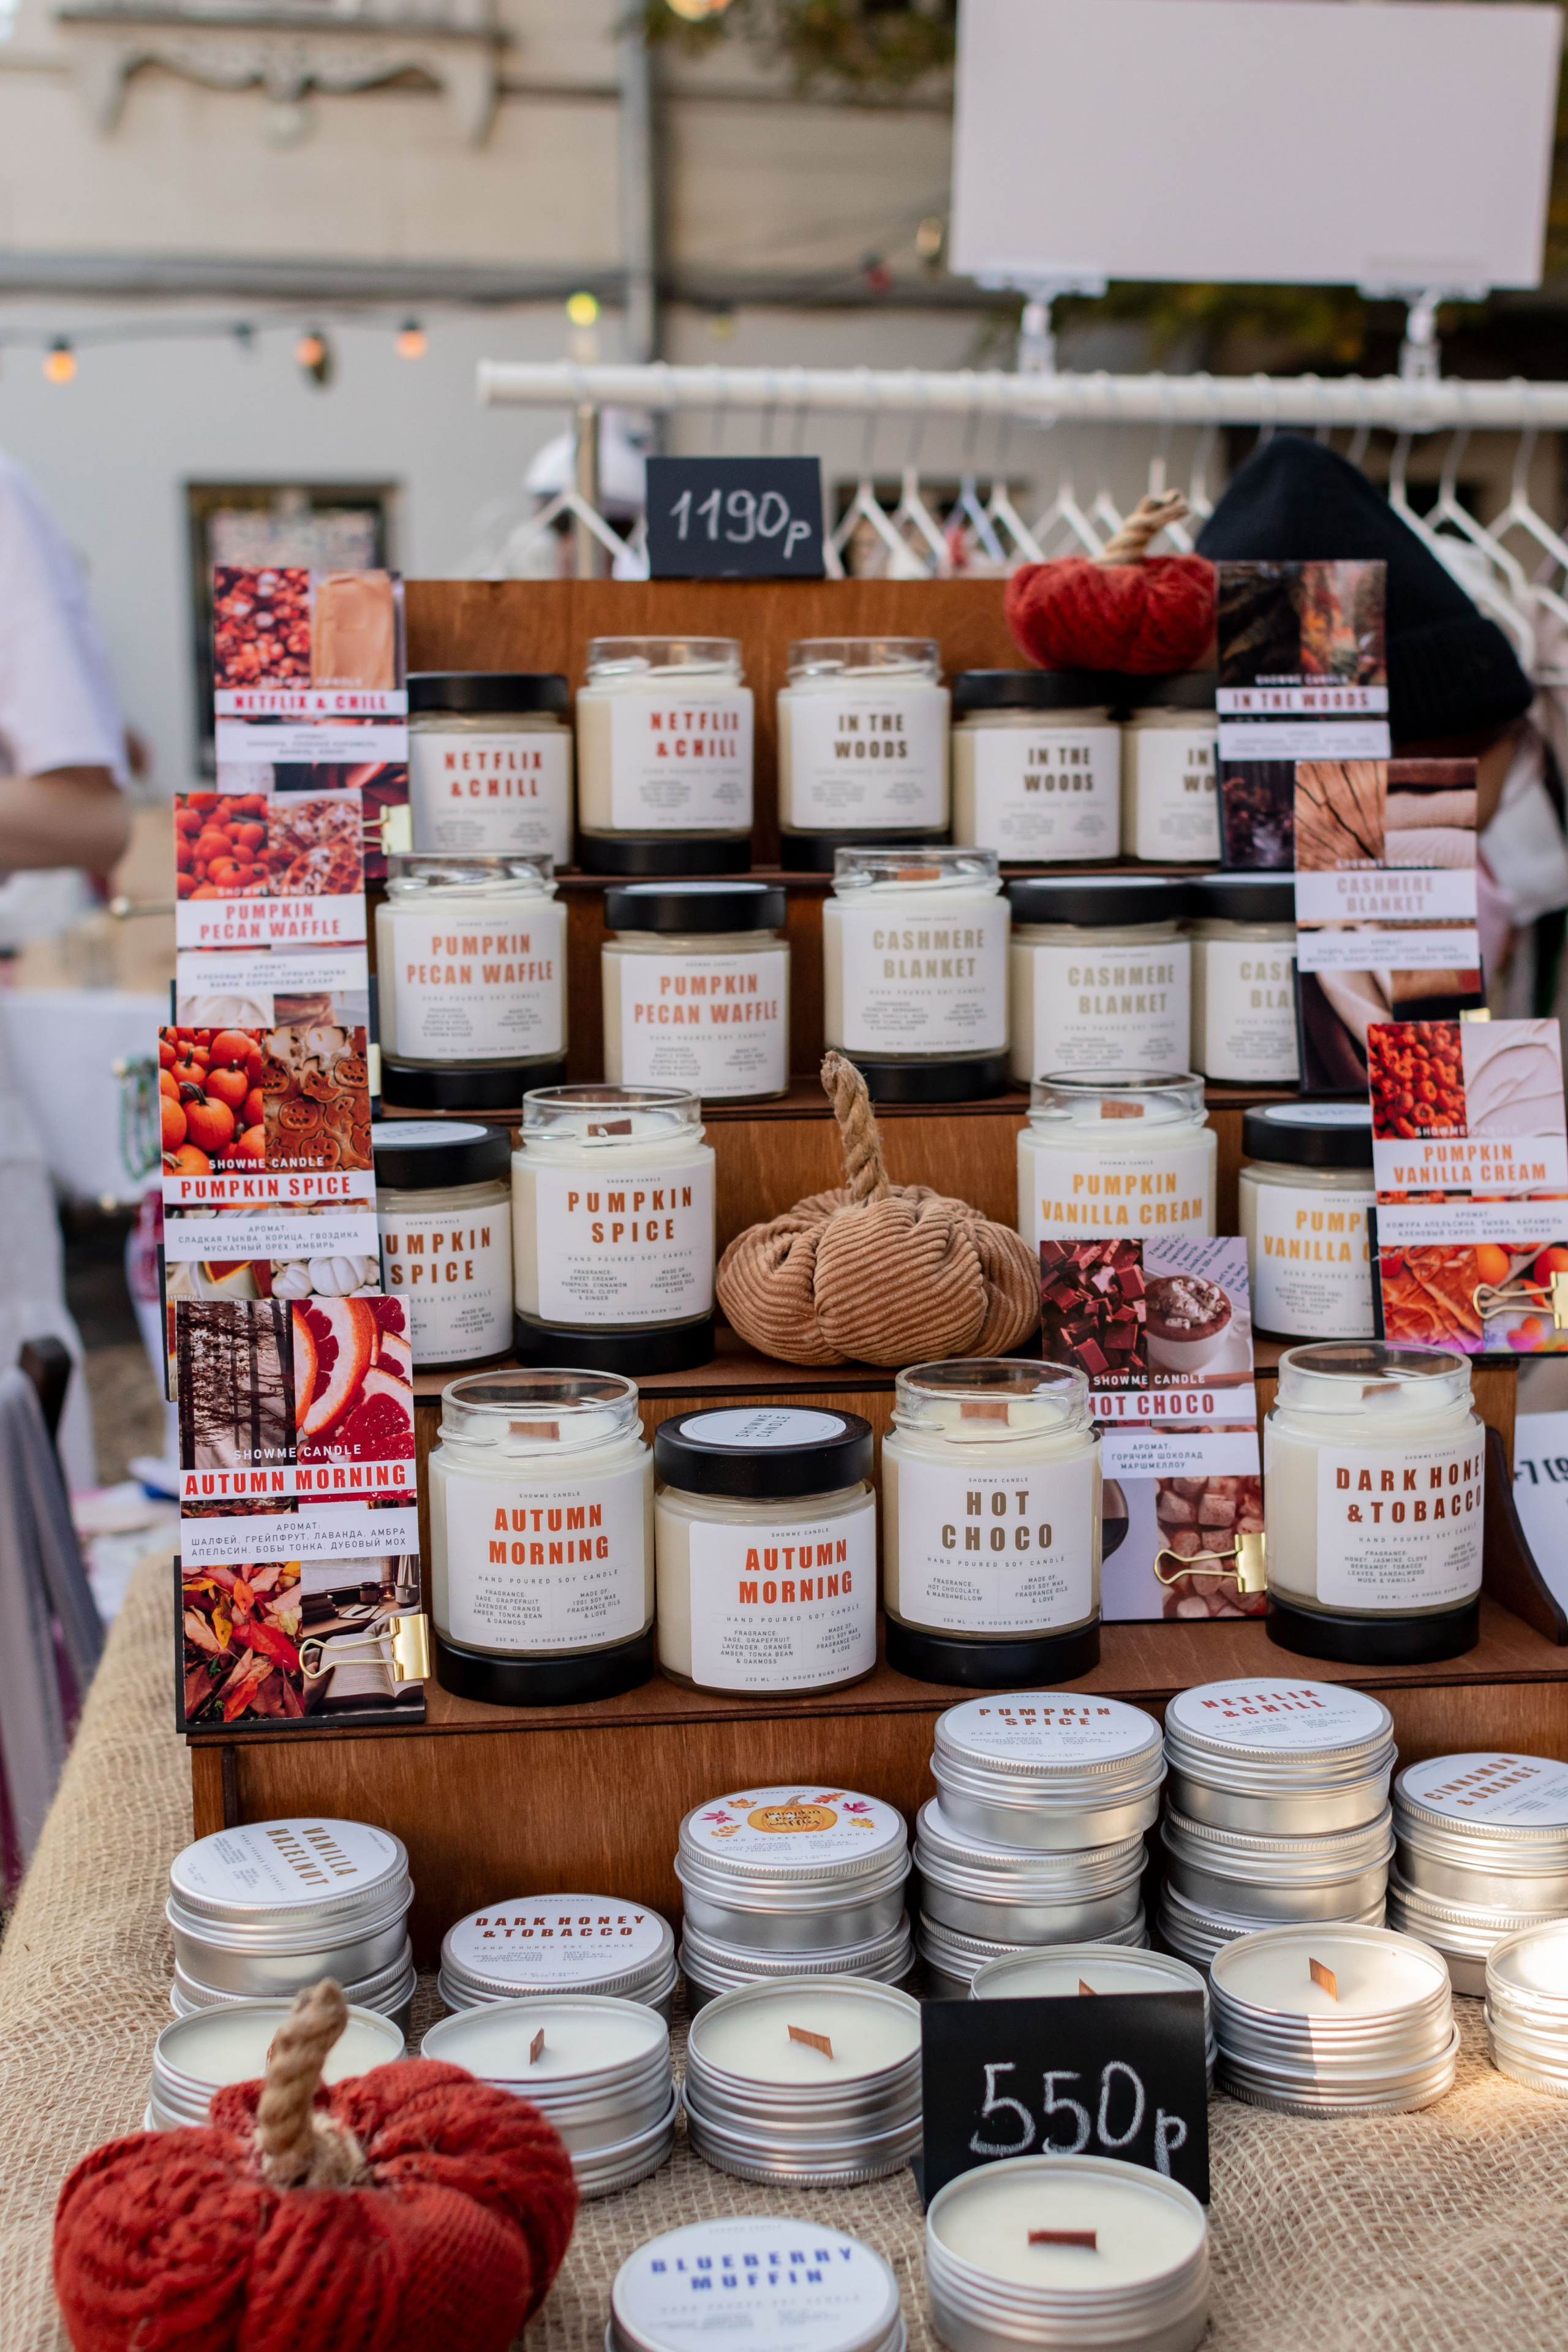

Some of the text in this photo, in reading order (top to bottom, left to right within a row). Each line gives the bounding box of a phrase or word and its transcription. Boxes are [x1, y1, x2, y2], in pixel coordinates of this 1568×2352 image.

[235, 696, 306, 709] NETFLIX
[336, 696, 386, 710] CHILL
[1234, 693, 1368, 707] IN THE WOODS
[839, 714, 904, 732] IN THE
[834, 741, 907, 758] WOODS
[1028, 747, 1090, 765] IN THE
[1188, 749, 1208, 766] IN
[445, 752, 541, 769] NETFLIX
[1023, 774, 1094, 791] WOODS
[1336, 876, 1433, 894] CASHMERE
[226, 903, 314, 920] PUMPKIN
[1347, 897, 1424, 913] BLANKET
[200, 919, 341, 940] PECAN WAFFLE
[873, 929, 984, 950] CASHMERE
[432, 934, 530, 956] PUMPKIN
[407, 960, 553, 984] PECAN WAFFLE
[883, 958, 975, 979] BLANKET
[1068, 964, 1175, 987] CASHMERE
[660, 974, 758, 995] PUMPKIN
[635, 1000, 778, 1024] PECAN WAFFLE
[1079, 993, 1167, 1015] BLANKET
[1415, 1125, 1466, 1137] SHOWME
[209, 1156, 324, 1170] SHOWME CANDLE
[1424, 1144, 1512, 1163] PUMPKIN
[1393, 1163, 1546, 1183] VANILLA CREAM
[181, 1177, 350, 1198] PUMPKIN SPICE
[1073, 1173, 1177, 1196] PUMPKIN
[568, 1186, 692, 1213] PUMPKIN
[1042, 1198, 1203, 1225] VANILLA CREAM
[592, 1219, 674, 1243] SPICE
[204, 1243, 262, 1251] МУСКАТНЫЙ
[1264, 1235, 1351, 1262] VANILLA
[391, 1260, 473, 1285] SPICE
[1094, 1374, 1205, 1385] SHOWME CANDLE
[1137, 1394, 1214, 1415] CHOCO
[736, 1414, 772, 1438] SHOWME
[756, 1415, 791, 1438] CANDLE
[234, 1444, 361, 1460] SHOWME CANDLE
[1112, 1451, 1153, 1460] ГОРЯЧИЙ
[1121, 1461, 1185, 1470] МАРШМЕЛЛОУ
[185, 1464, 406, 1496] AUTUMN MORNING
[1336, 1468, 1417, 1491] DARK
[967, 1491, 1029, 1517] HOT
[277, 1522, 321, 1531] АРОМАТ:
[494, 1504, 601, 1532] AUTUMN
[371, 1528, 405, 1537] АМБРА
[942, 1523, 1052, 1551] CHOCO
[255, 1545, 285, 1553] БОБЫ
[331, 1538, 381, 1551] ДУБОВЫЙ
[385, 1537, 407, 1546] МОХ
[489, 1536, 608, 1565] MORNING
[745, 1539, 846, 1571] AUTUMN
[1030, 1556, 1065, 1566] CANDLE
[739, 1570, 852, 1604] MORNING
[932, 1591, 982, 1601] MARSHMELLOW
[942, 1585, 981, 1594] CHOCOLATE
[831, 1604, 859, 1616] CANDLE
[816, 1637, 850, 1649] FRAGRANCE
[837, 1644, 850, 1653] LOVE
[1200, 1690, 1319, 1709] NETFLIX
[1423, 1758, 1519, 1800] CINNAMON
[1468, 1766, 1541, 1799] ORANGE
[764, 1809, 821, 1819] pumpkin
[265, 1828, 330, 1886] HAZELNUT
[301, 1826, 358, 1877] VANILLA
[475, 1915, 646, 1926] DARK HONEY
[650, 2247, 852, 2274] BLUEBERRY
[691, 2270, 823, 2291] MUFFIN
